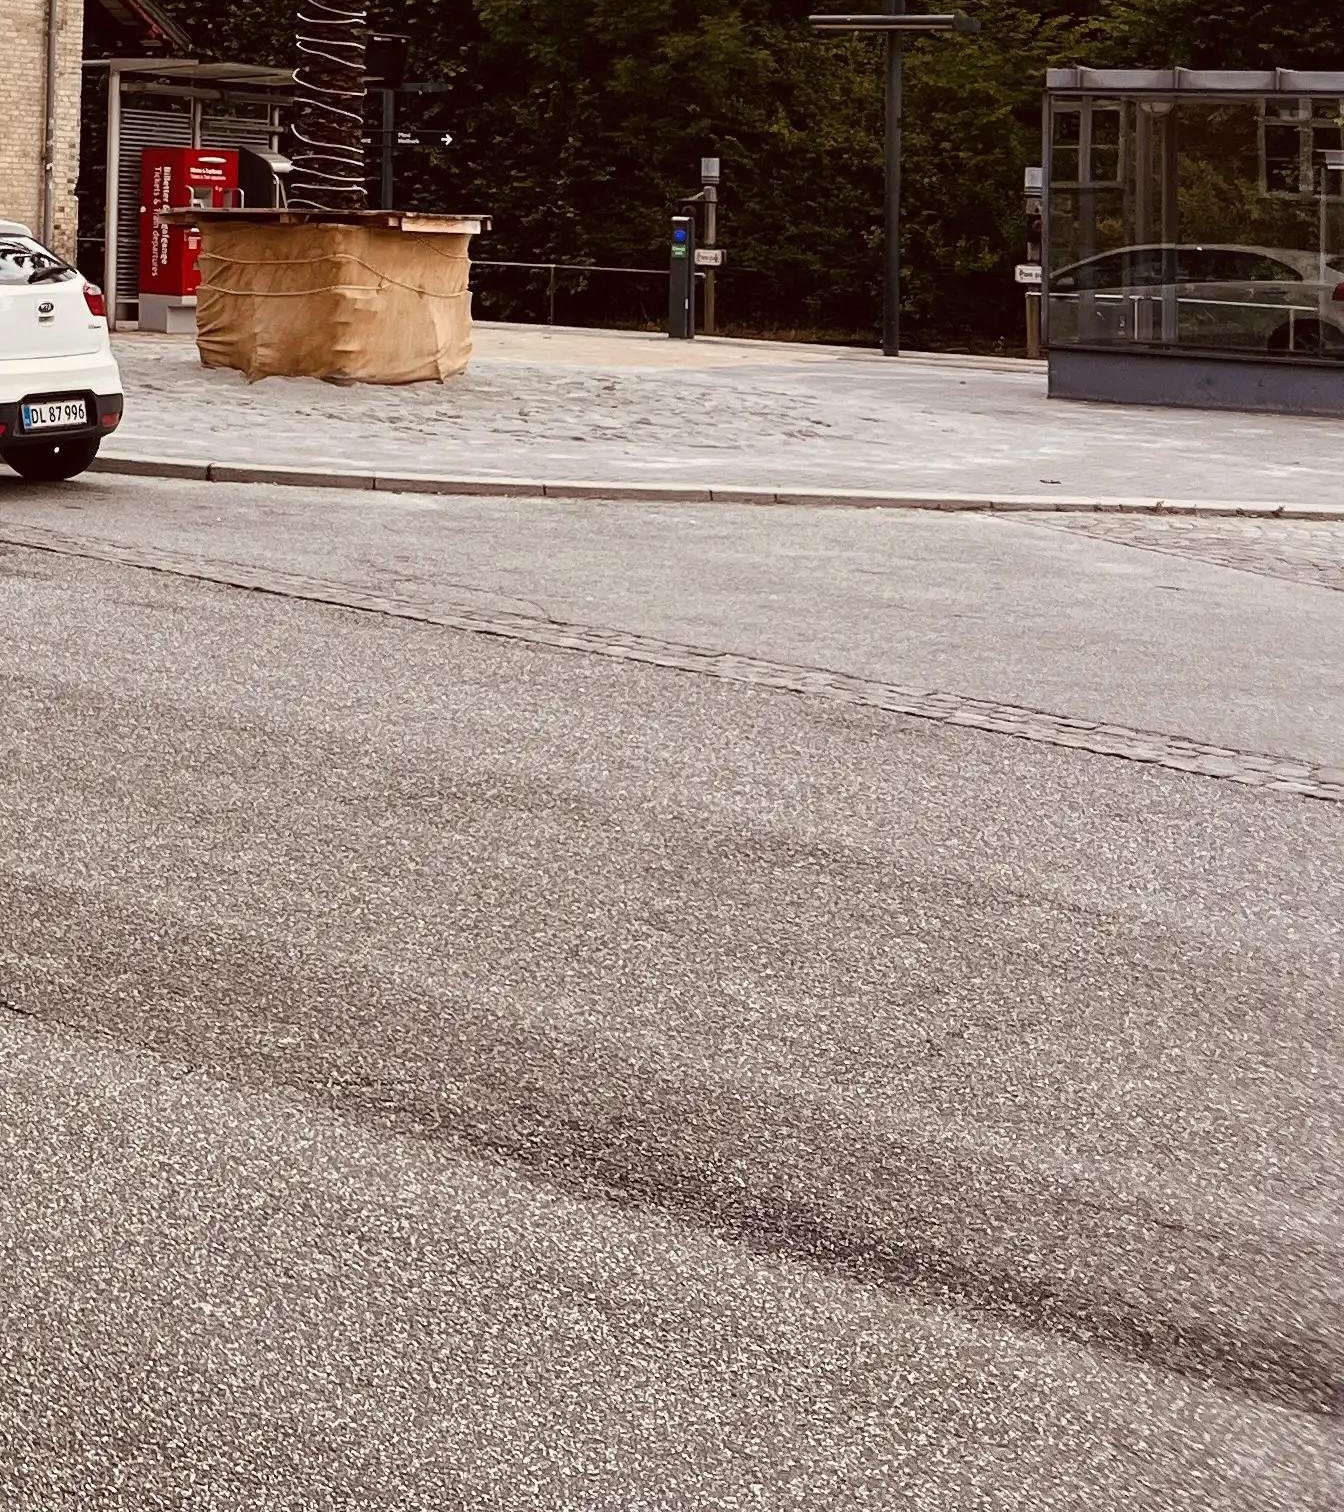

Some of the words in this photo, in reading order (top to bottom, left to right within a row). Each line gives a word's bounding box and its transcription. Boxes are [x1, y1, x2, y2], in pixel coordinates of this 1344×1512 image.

[154, 166, 162, 196] Tickets
[163, 167, 171, 202] Billetter
[151, 230, 160, 276] departures
[32, 407, 46, 423] DL
[49, 406, 62, 422] 87
[65, 404, 85, 420] 996
